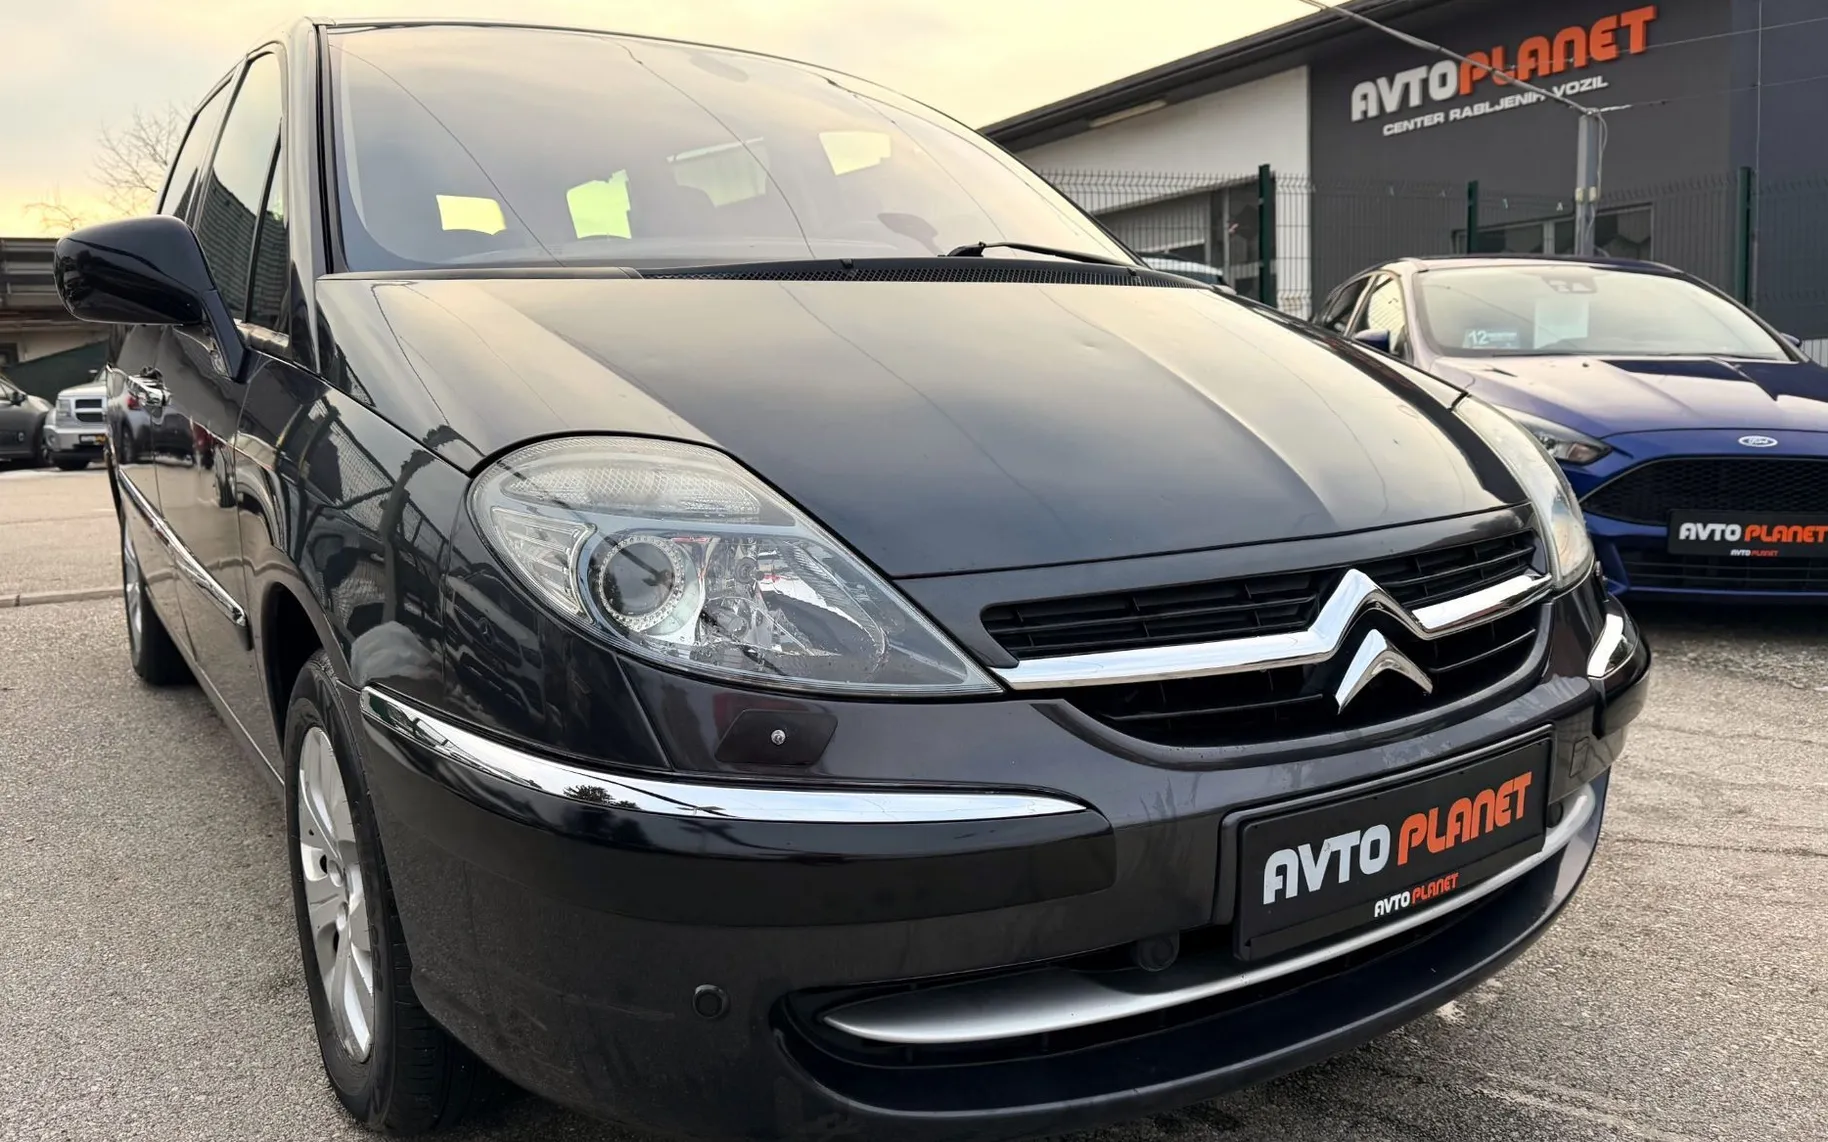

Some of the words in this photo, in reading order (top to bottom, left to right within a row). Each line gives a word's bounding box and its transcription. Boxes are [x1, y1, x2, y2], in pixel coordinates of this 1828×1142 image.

[1383, 110, 1445, 136] CENTER
[1551, 75, 1609, 98] VOZIL
[1468, 330, 1489, 345] 12
[1679, 522, 1741, 541] AVTO
[1744, 524, 1828, 543] PLANET
[1263, 824, 1391, 904] AVTO
[1397, 771, 1532, 866] PLANET
[1374, 891, 1410, 918] AVTO
[1412, 872, 1459, 905] PLANET
